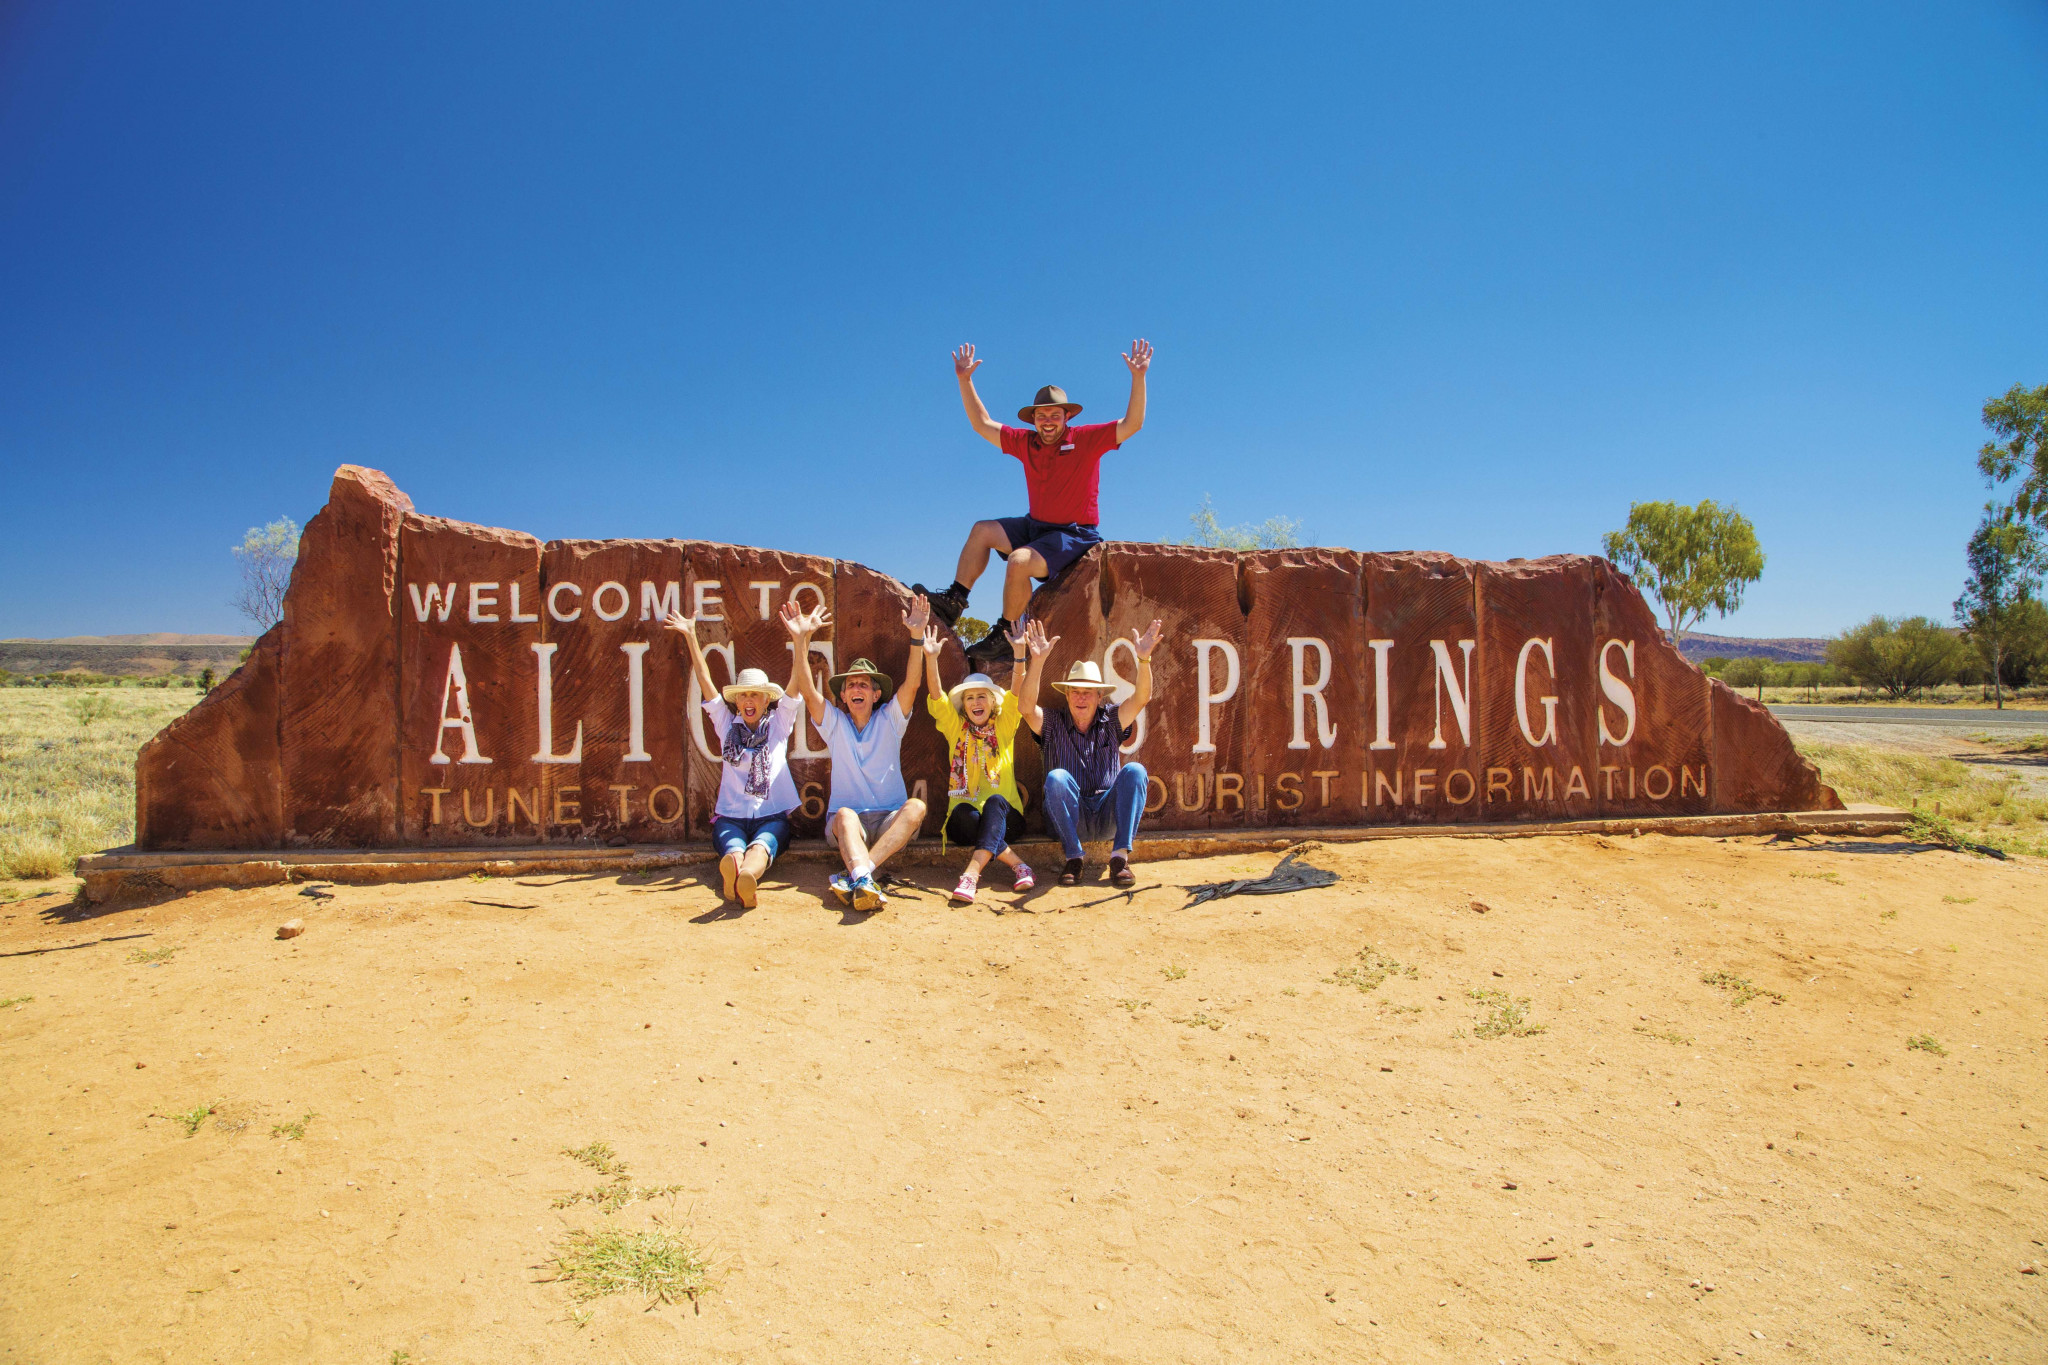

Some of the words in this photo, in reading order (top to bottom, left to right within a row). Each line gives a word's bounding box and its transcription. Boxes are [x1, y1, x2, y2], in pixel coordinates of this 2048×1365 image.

[408, 580, 725, 623] WELCOME
[749, 580, 826, 621] TO
[1103, 636, 1636, 754] SPRINGS
[420, 786, 582, 827] TUNE
[608, 783, 684, 824] TO
[1146, 769, 1340, 814] OURIST
[1360, 764, 1708, 808] INFORMATION
